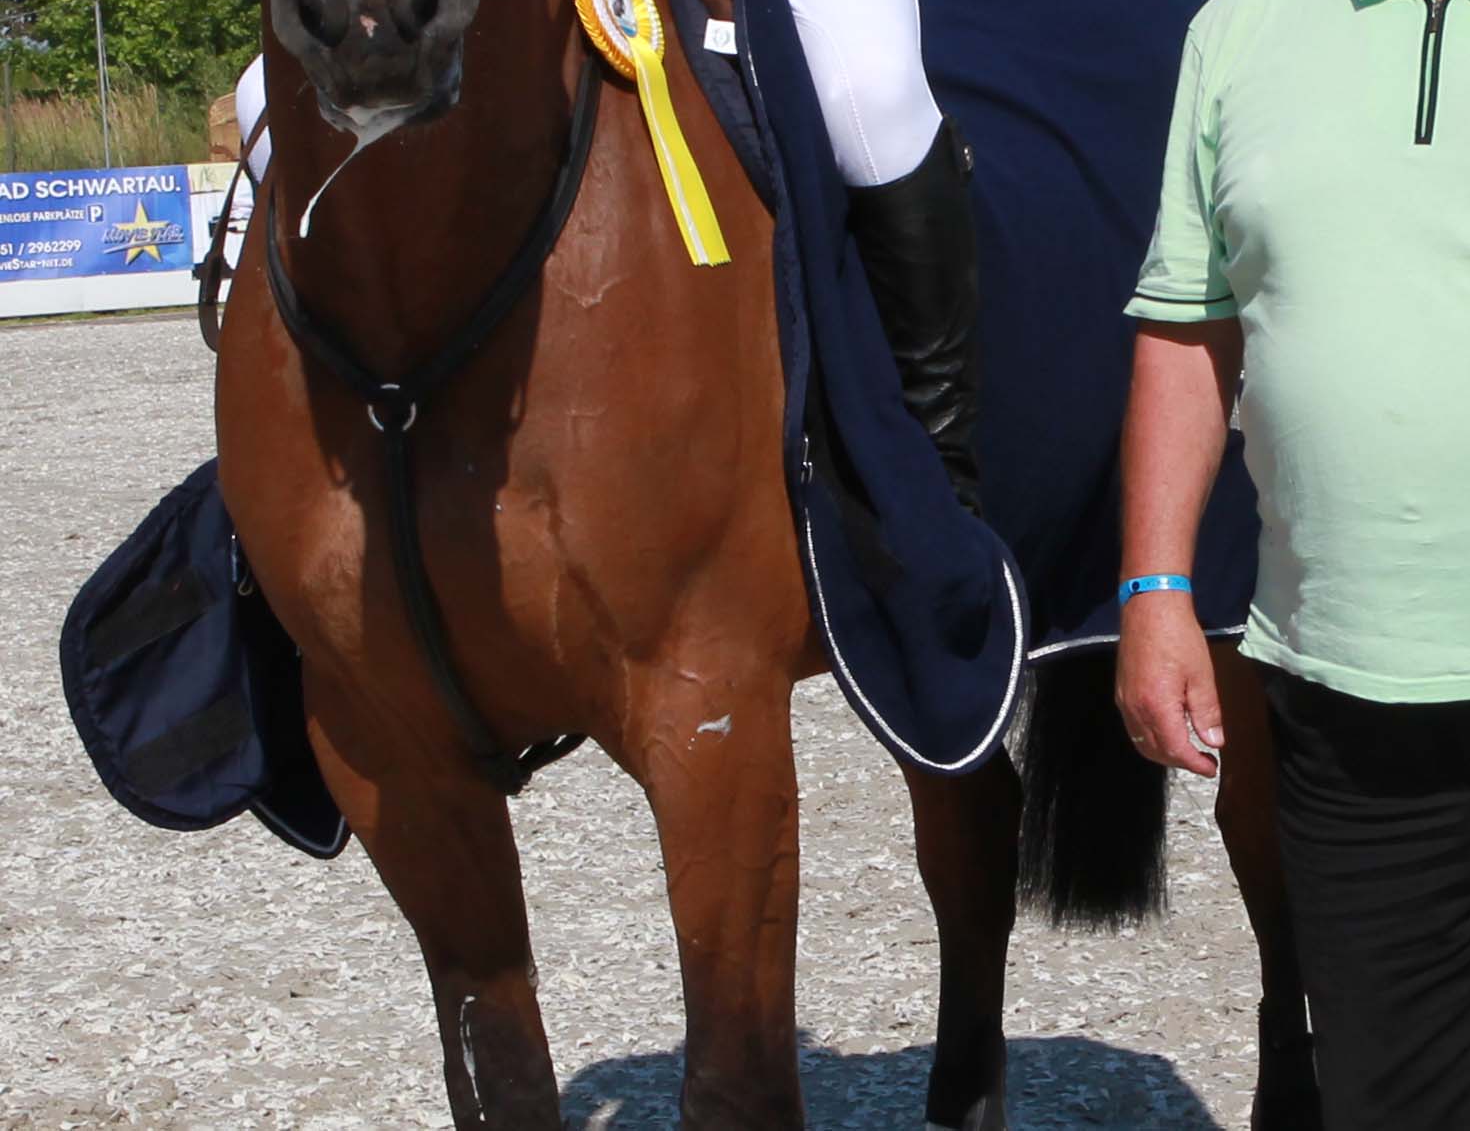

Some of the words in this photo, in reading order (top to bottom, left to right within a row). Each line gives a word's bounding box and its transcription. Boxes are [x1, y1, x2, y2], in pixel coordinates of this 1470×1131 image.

[35, 175, 181, 199] SCHWARTAU.
[33, 209, 85, 222] PARKPLÄTZE
[28, 239, 82, 254] 2962299
